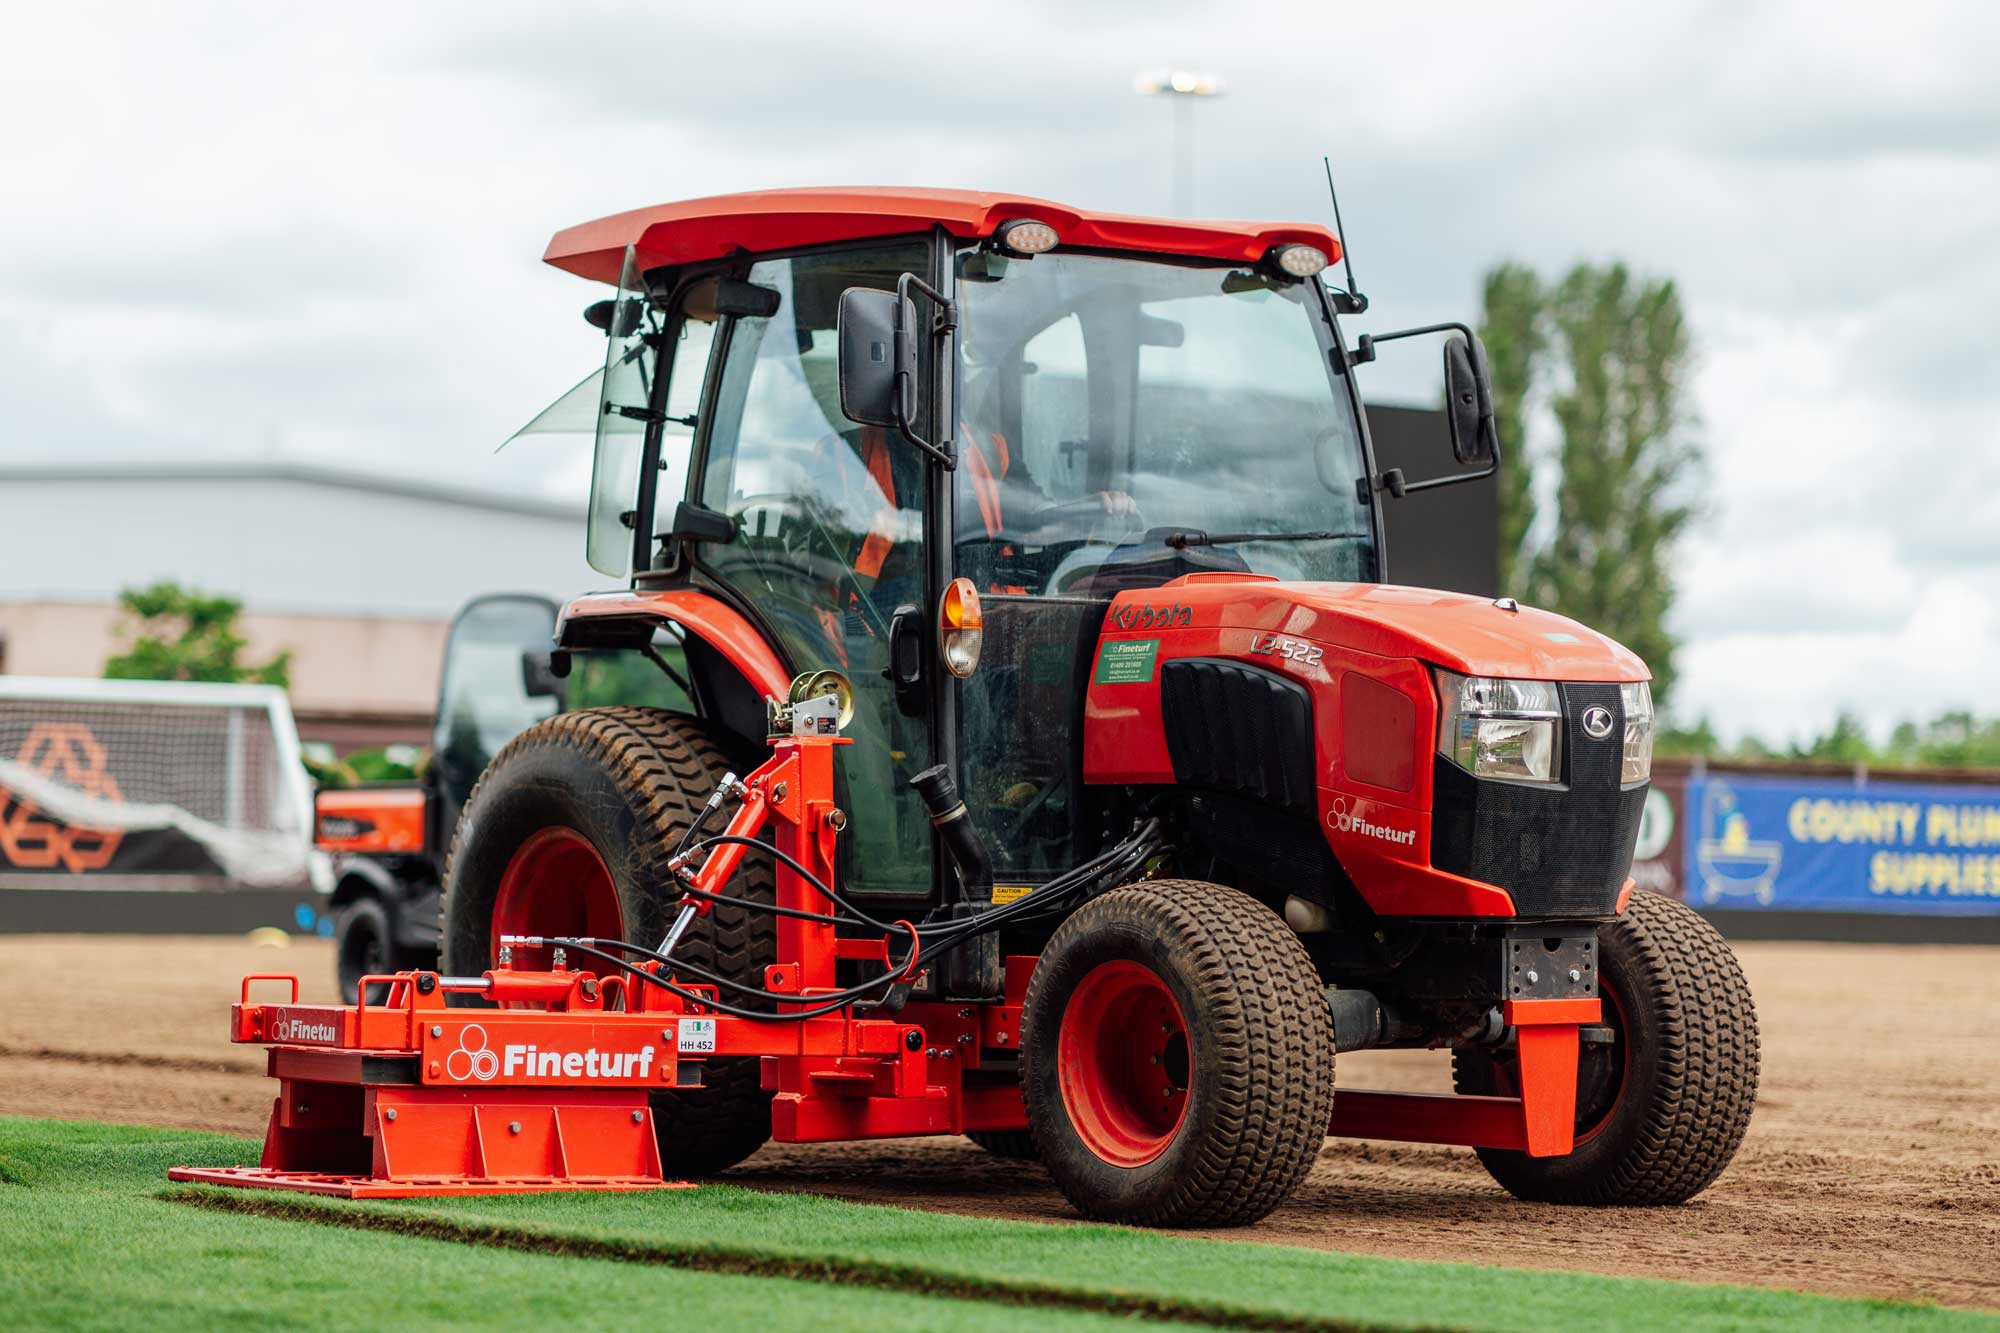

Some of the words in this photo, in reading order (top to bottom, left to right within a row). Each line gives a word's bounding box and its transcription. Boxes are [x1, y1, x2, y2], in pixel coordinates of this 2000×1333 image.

[1109, 600, 1193, 628] Kubota
[1118, 642, 1151, 653] Fineturf
[1250, 635, 1324, 667] L2-522
[1352, 817, 1416, 845] Fineturf
[1789, 797, 1922, 846] COUNTY
[680, 1041, 694, 1050] HH
[697, 1041, 713, 1050] 452
[503, 1044, 655, 1078] Fineturf
